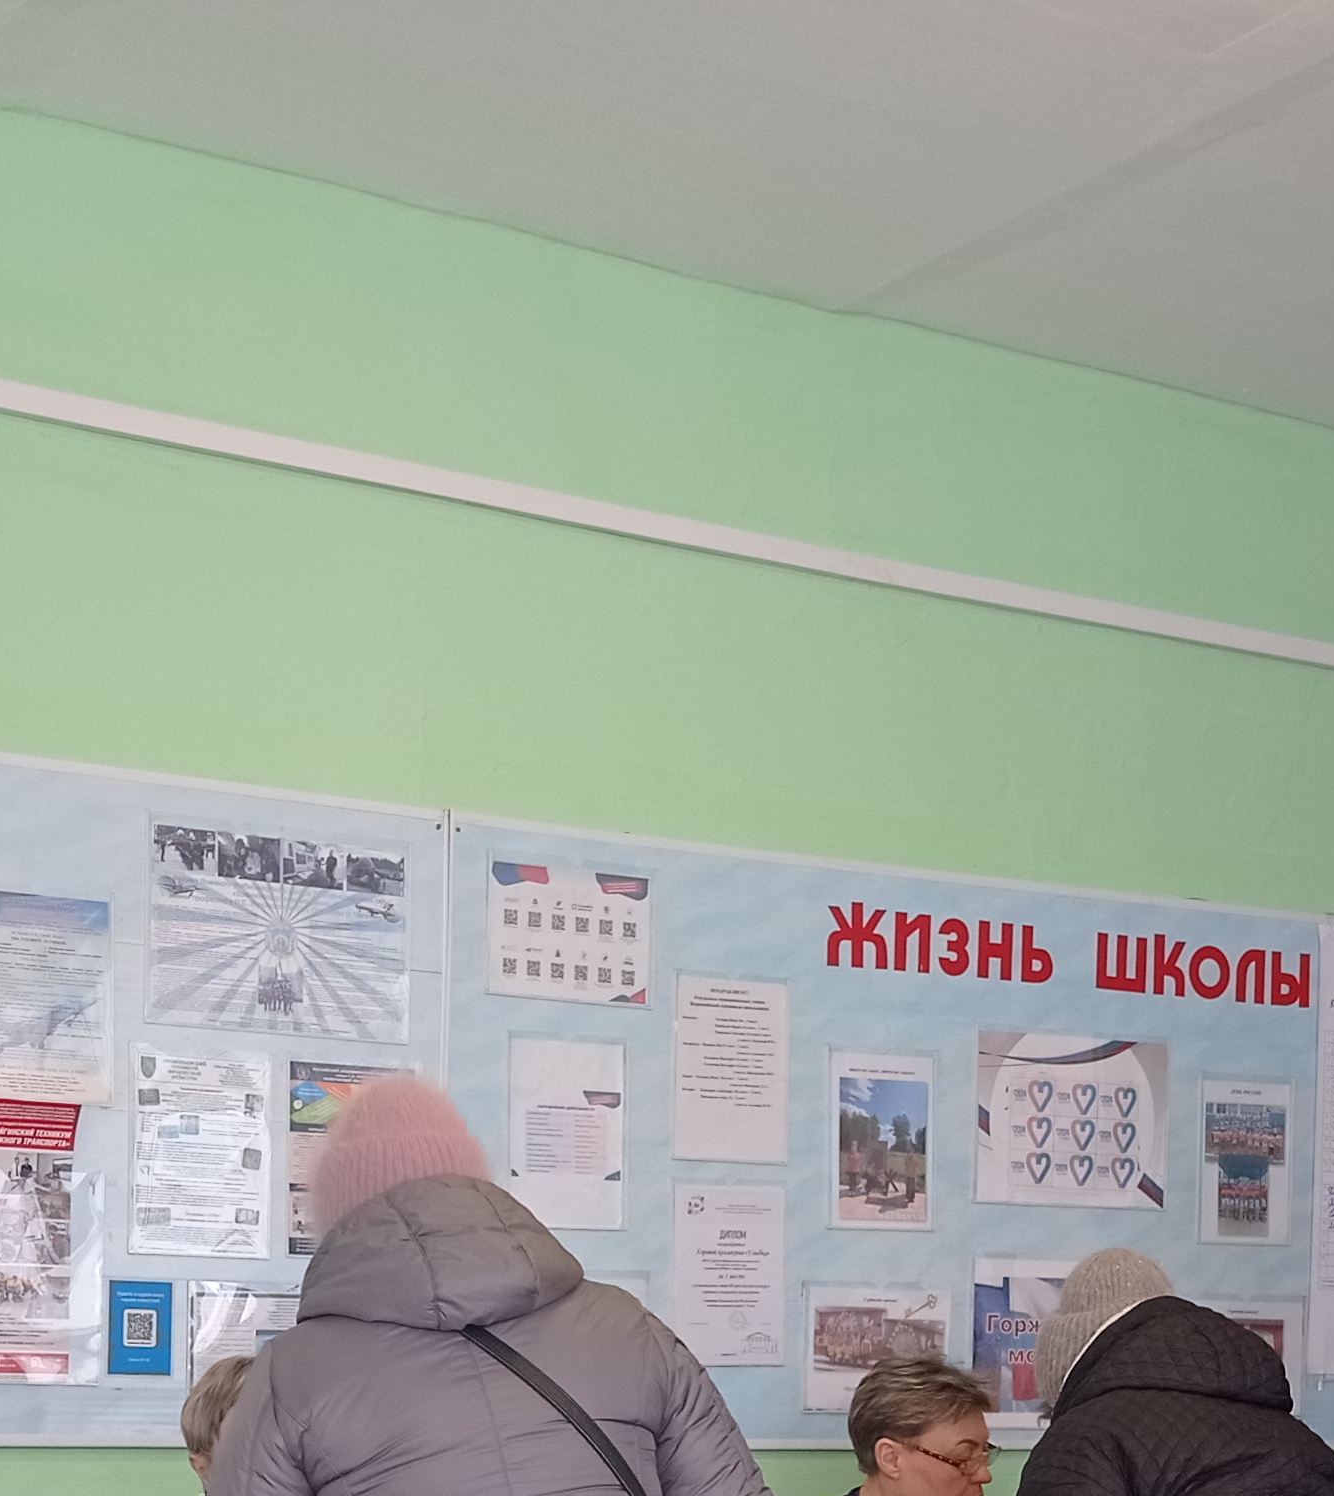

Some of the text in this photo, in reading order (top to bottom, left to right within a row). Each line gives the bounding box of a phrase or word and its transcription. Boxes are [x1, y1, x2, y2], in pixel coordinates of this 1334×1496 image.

[827, 902, 1311, 1008] ЖИЗНЬ ШКОЛЫ
[987, 1314, 1039, 1337] Горж
[1009, 1349, 1035, 1363] мо
